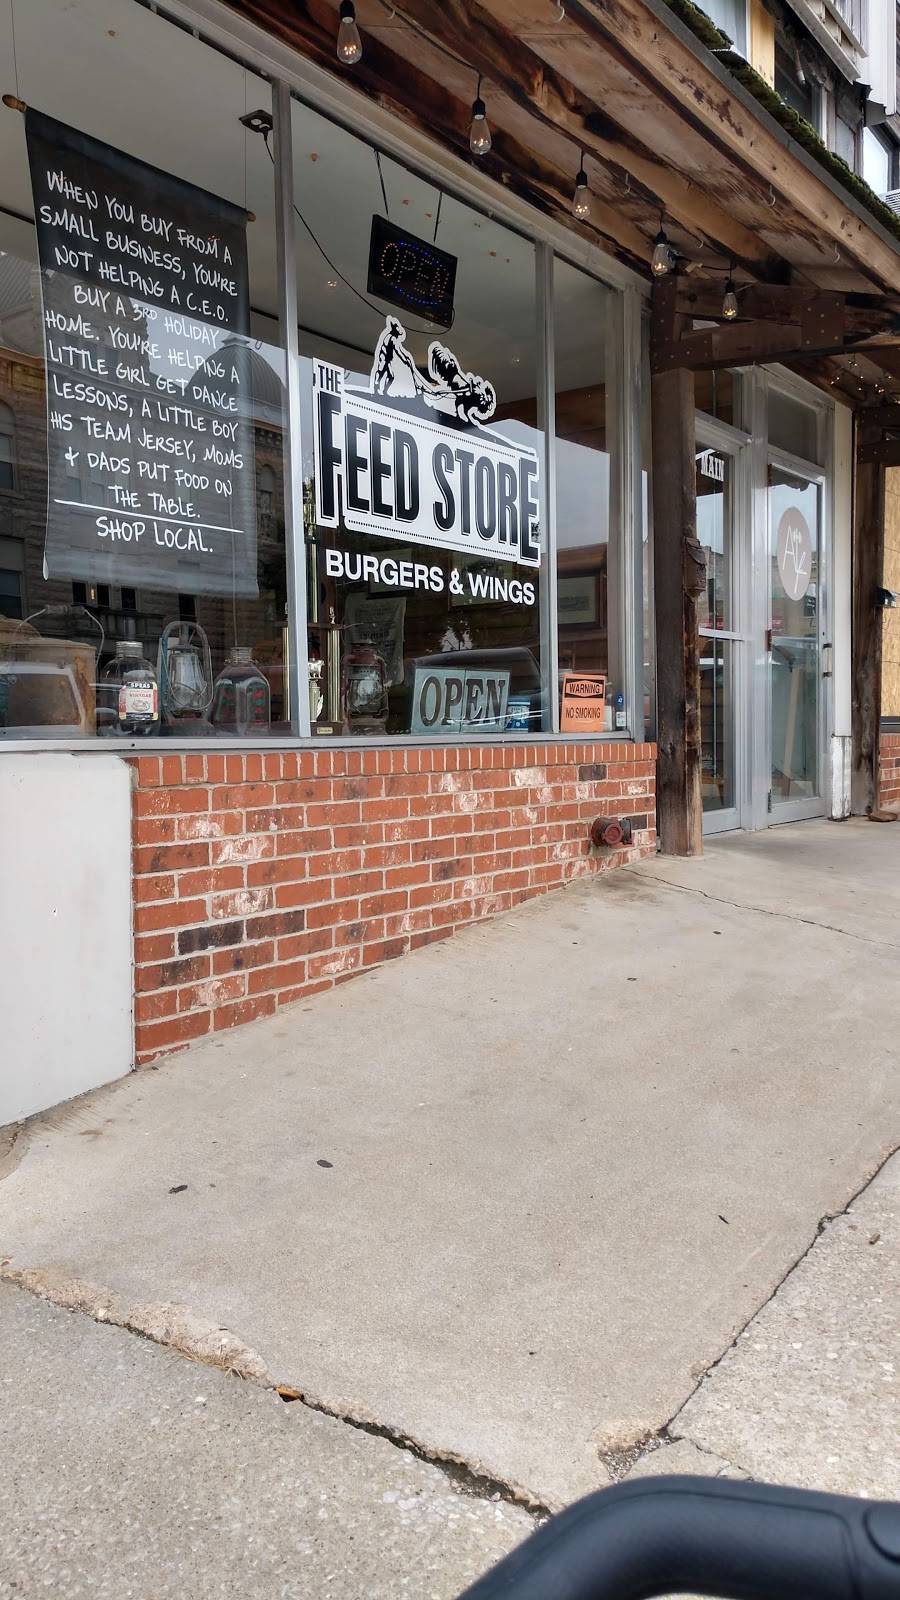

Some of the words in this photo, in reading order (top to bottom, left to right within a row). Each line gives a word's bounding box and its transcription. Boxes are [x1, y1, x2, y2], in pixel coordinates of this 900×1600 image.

[47, 170, 98, 210] WHEN
[105, 195, 134, 225] YOU
[140, 213, 173, 242] BUY
[177, 228, 220, 258] FROM
[223, 246, 233, 266] A
[40, 205, 99, 242] SMALL
[106, 231, 186, 280] BUSINESS,
[192, 263, 238, 297] YOU'RE
[381, 243, 449, 301] OPEN
[55, 246, 93, 271] NOT
[99, 262, 164, 298] HELPING
[170, 285, 180, 304] A
[187, 293, 229, 322] C.E.O.
[74, 285, 110, 313] BUY
[116, 297, 126, 317] A
[132, 303, 158, 322] 3RD
[165, 316, 220, 349] HOLIDAY
[45, 310, 100, 341] HOME.
[108, 326, 162, 360] YOU'RE
[168, 347, 226, 378] HELPING
[231, 365, 240, 384] A
[49, 339, 109, 376] LITTLE
[116, 363, 150, 387] GIRL
[156, 375, 188, 397] GET
[192, 385, 238, 412] DANCE
[53, 374, 133, 418] LESSONS,
[141, 398, 151, 419] A
[157, 401, 207, 432] LITTLE
[212, 419, 239, 442] BOY
[318, 364, 342, 394] THE
[51, 411, 73, 431] HIS
[81, 415, 131, 443] TEAM
[137, 428, 196, 463] JERSEY,
[203, 444, 244, 470] MOMS
[701, 453, 724, 482] MAIN
[64, 446, 79, 467] &
[88, 451, 131, 475] DADS
[137, 460, 170, 483] PUT
[175, 469, 209, 490] FOOD
[215, 479, 233, 497] ON
[319, 390, 420, 523] FEED
[432, 442, 540, 561] STORE
[108, 484, 141, 508] THE
[147, 491, 201, 518] TABLE.
[96, 516, 146, 542] SHOP
[153, 522, 214, 552] LOCAL.
[326, 549, 444, 592] BURGERS
[449, 568, 464, 596] &
[468, 572, 535, 606] WINGS
[419, 676, 506, 727] OPEN
[565, 707, 575, 719] NO
[575, 707, 601, 719] SMOKING
[569, 683, 601, 694] WARNING
